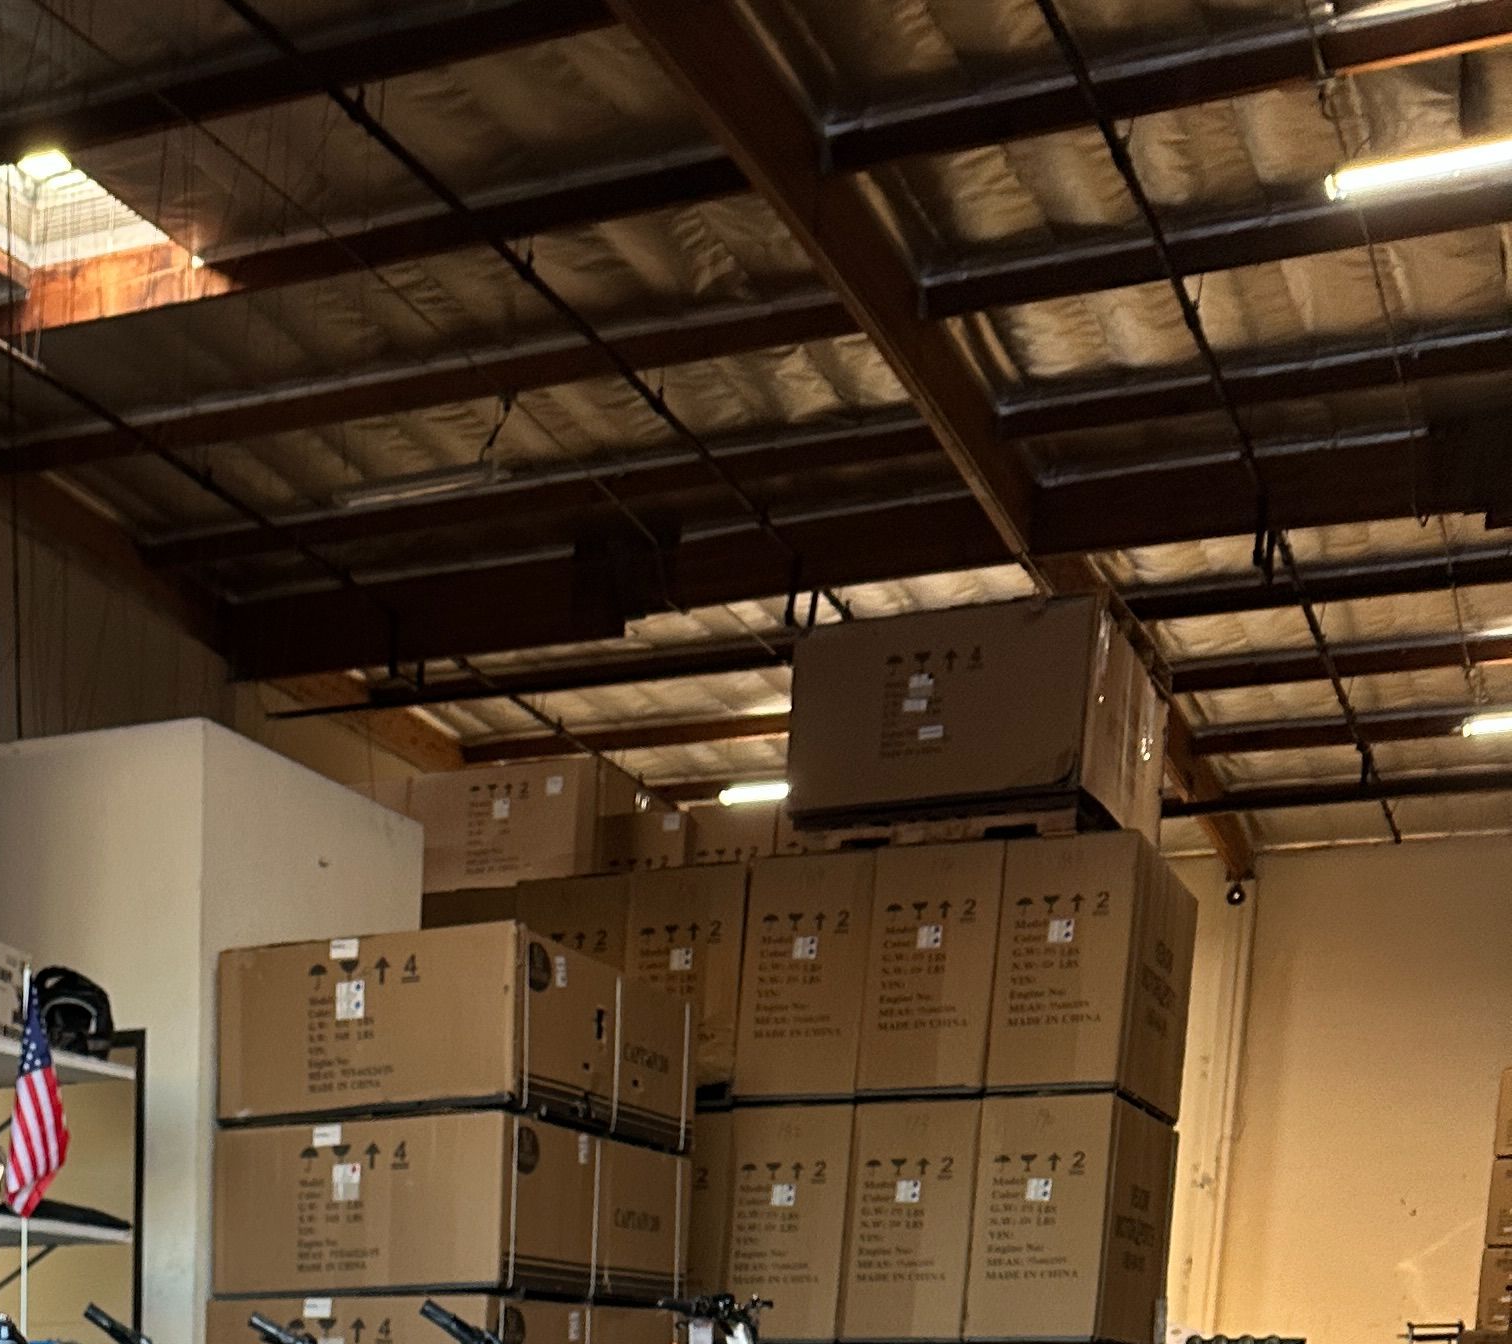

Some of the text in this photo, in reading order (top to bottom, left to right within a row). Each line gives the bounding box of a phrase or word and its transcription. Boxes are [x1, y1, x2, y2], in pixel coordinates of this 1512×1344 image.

[963, 898, 976, 916] 2
[1097, 891, 1110, 909] 2
[837, 910, 850, 928] 2
[404, 953, 418, 977] 4
[394, 1140, 408, 1161] 4
[1072, 1150, 1086, 1169] 2
[814, 1161, 827, 1178] 2
[940, 1156, 954, 1173] 2
[378, 1317, 392, 1337] 4
